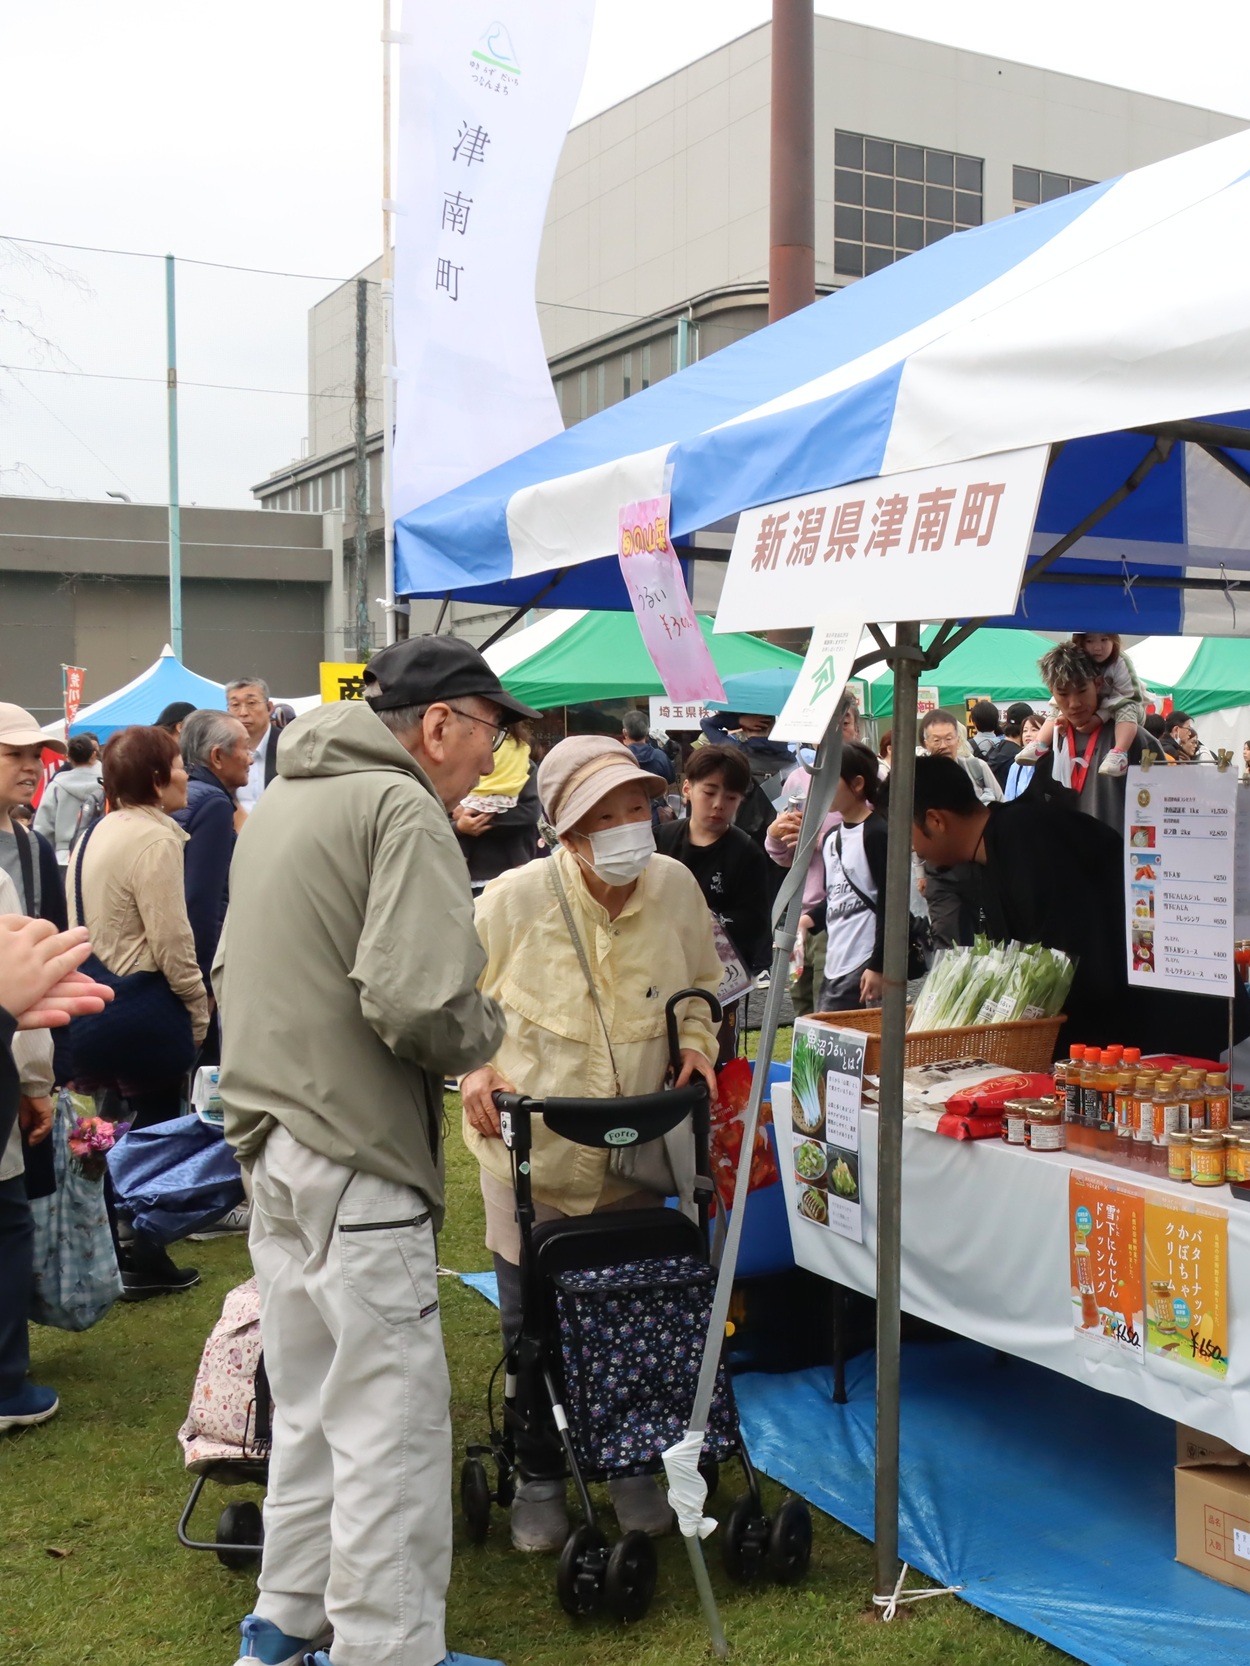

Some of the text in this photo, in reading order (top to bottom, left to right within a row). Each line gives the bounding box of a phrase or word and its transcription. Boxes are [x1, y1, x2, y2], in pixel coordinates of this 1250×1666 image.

[435, 120, 491, 301] 津南町
[751, 482, 1006, 572] 新潟県津南町
[635, 585, 666, 610] うるい
[805, 1028, 846, 1057] 魚沼うるい
[608, 1130, 636, 1141] Forte
[1096, 1202, 1107, 1293] ドレッシング
[1105, 1204, 1118, 1298] 雪下にんじん
[1165, 1222, 1175, 1290] クリーム
[1178, 1225, 1189, 1297] かぼちゃ
[1191, 1230, 1202, 1326] バターナッツ
